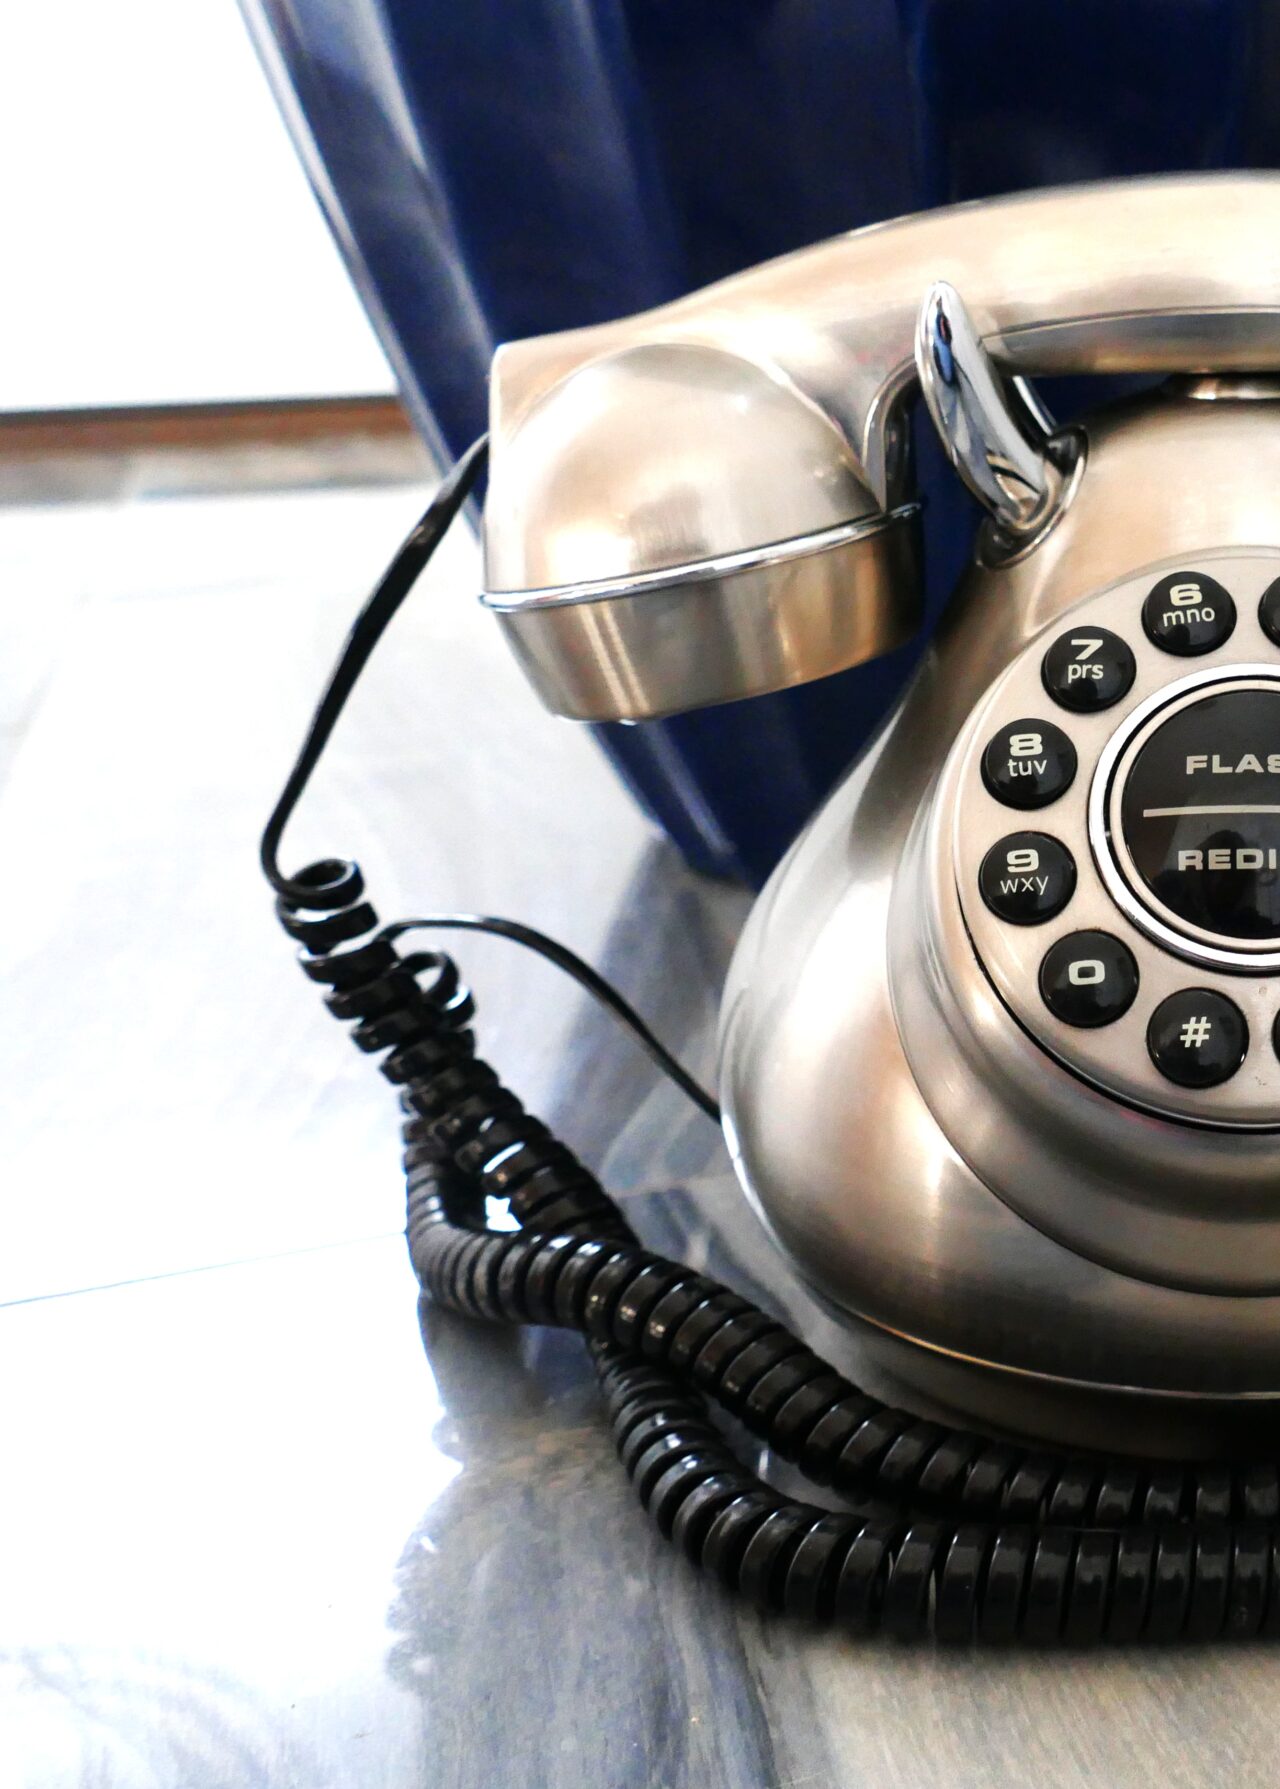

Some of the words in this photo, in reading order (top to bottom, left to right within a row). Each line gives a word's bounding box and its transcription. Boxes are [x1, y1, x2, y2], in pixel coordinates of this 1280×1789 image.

[1170, 583, 1202, 606] 6
[1163, 607, 1215, 627] mno
[1071, 639, 1103, 660] 7
[1067, 662, 1104, 683] prs
[1009, 733, 1043, 756] 8
[1007, 758, 1048, 777] tuv
[1007, 848, 1039, 873] 9
[1000, 875, 1049, 895] wxy
[1180, 1016, 1211, 1048] #
